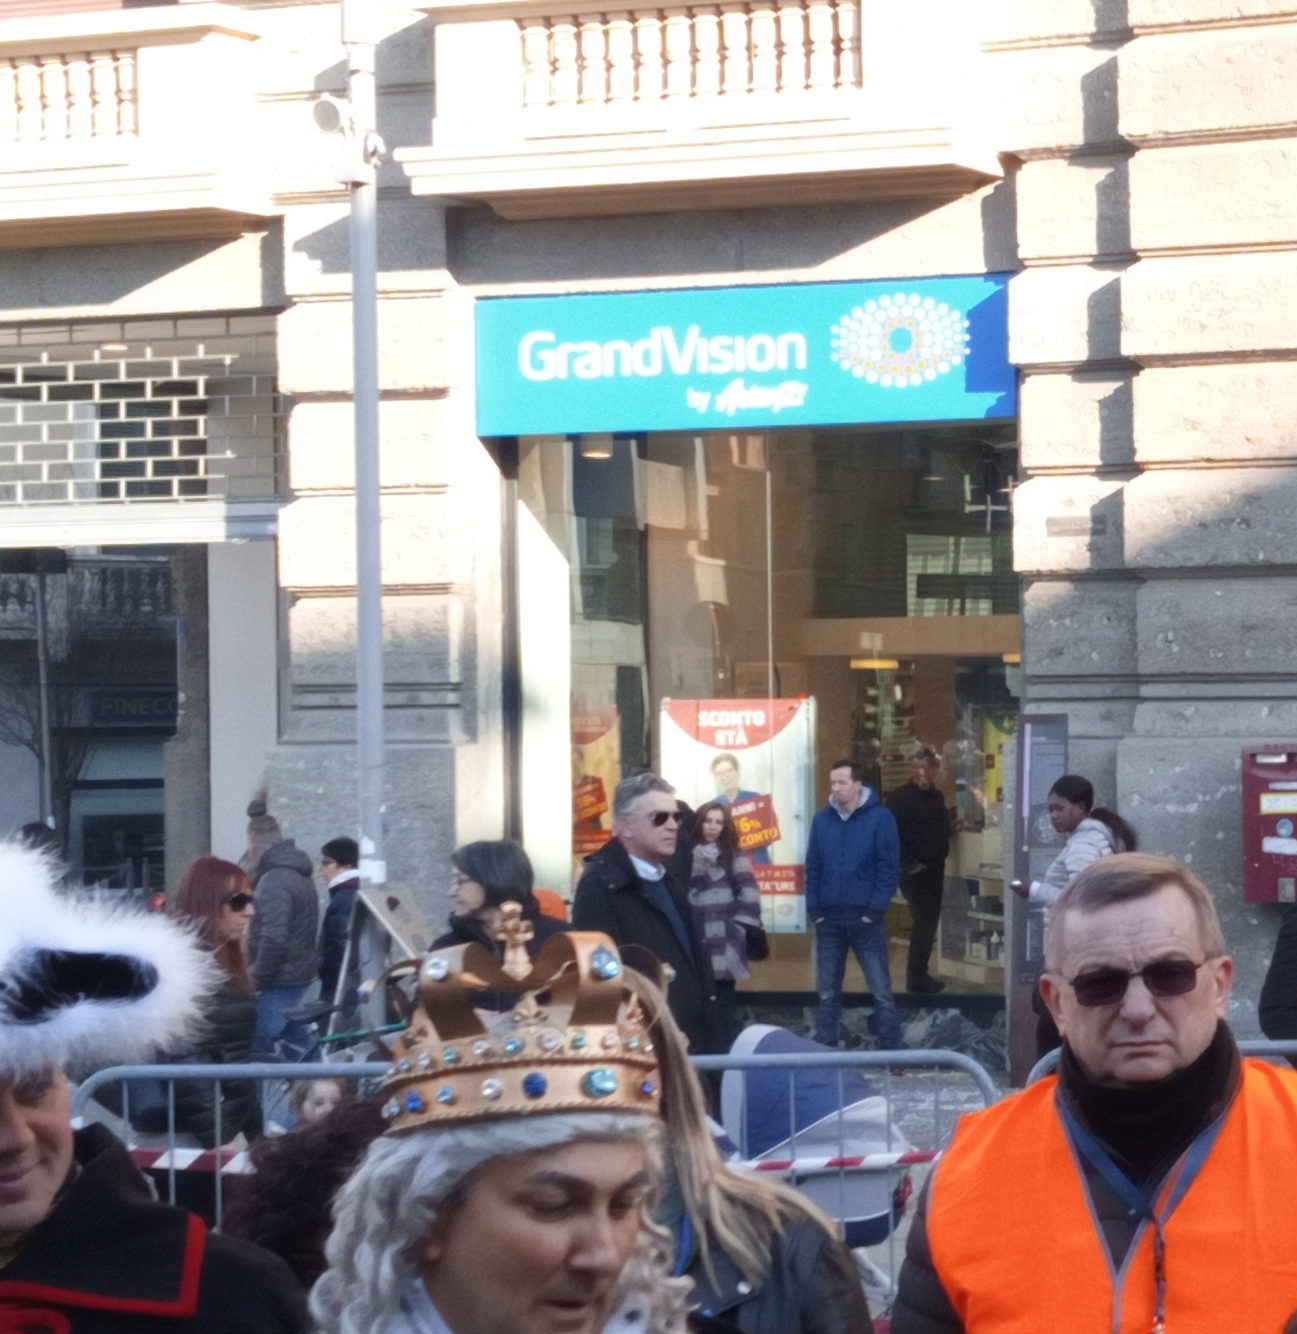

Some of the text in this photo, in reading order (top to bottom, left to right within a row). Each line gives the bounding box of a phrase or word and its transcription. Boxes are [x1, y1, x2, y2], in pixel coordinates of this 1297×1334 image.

[519, 324, 807, 381] GrandVision
[686, 387, 710, 413] by
[698, 710, 765, 727] SCONTO
[715, 726, 748, 746] ETÀ
[735, 816, 761, 833] 6%
[739, 828, 778, 846] CONTO
